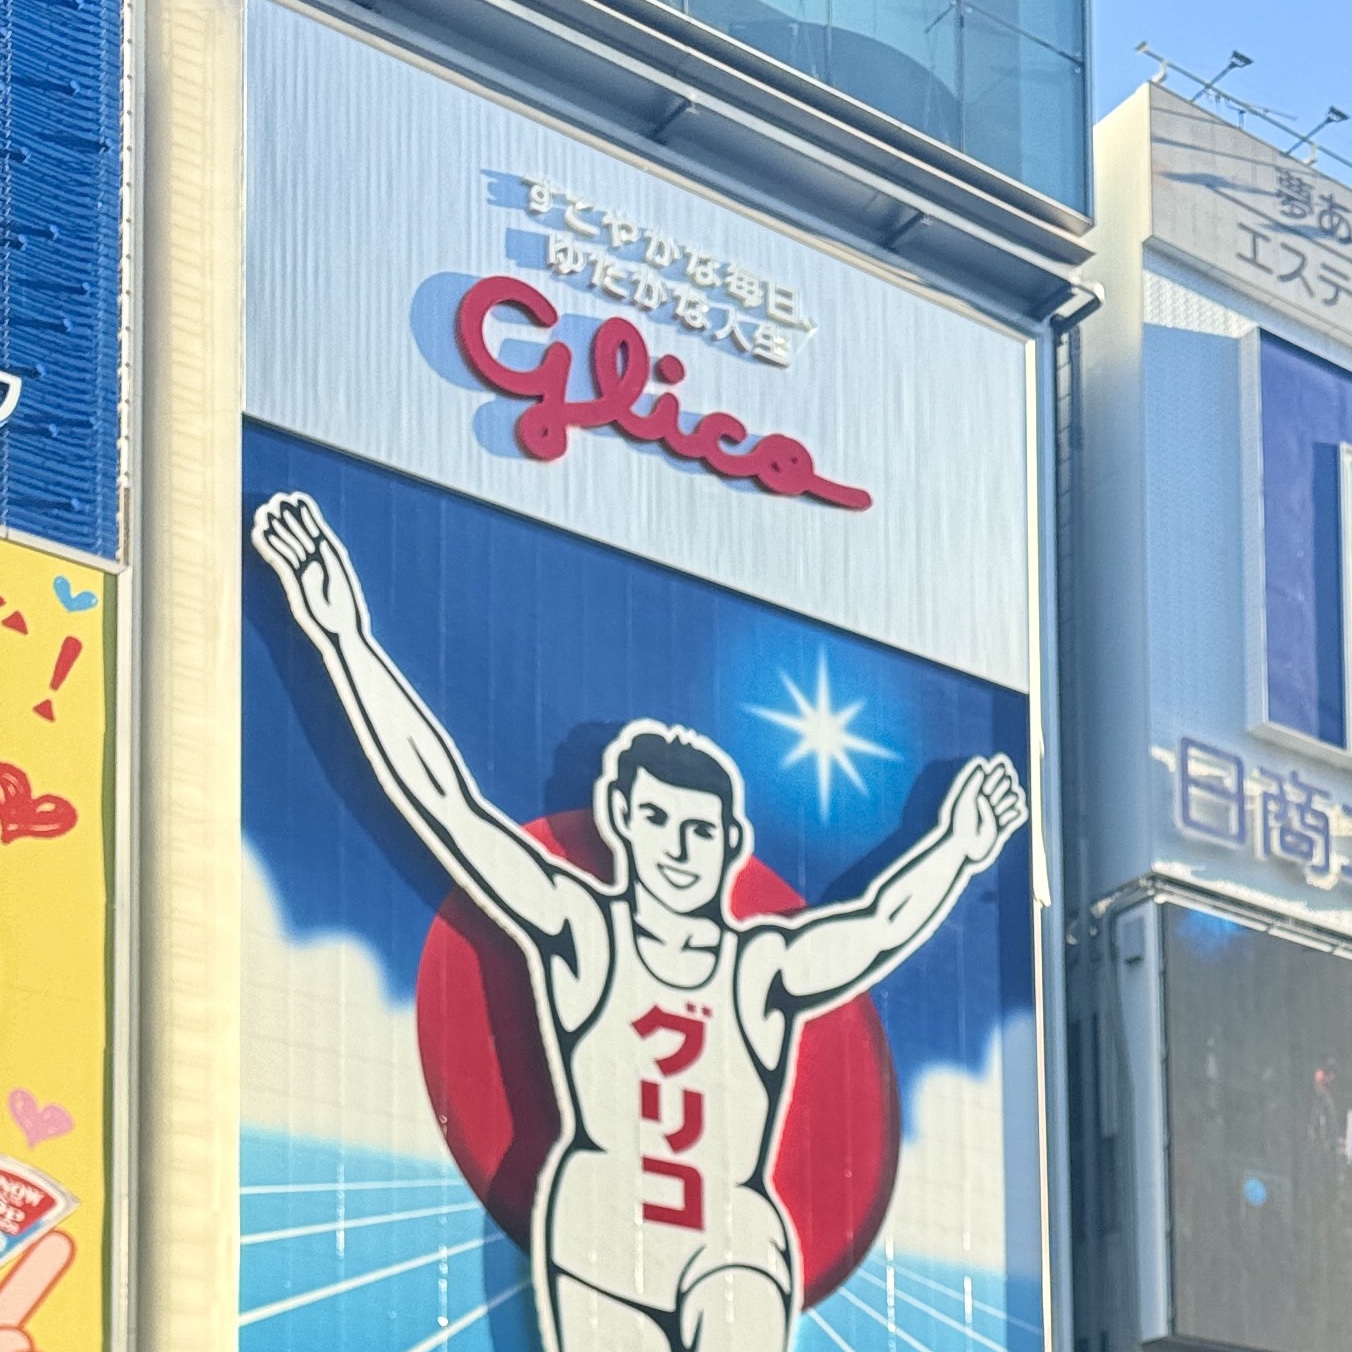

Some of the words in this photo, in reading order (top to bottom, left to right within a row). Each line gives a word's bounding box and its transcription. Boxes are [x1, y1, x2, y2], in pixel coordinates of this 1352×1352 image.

[456, 275, 874, 512] Glico
[545, 230, 790, 369] ゆたかな人生
[631, 1001, 713, 1232] グリコ
